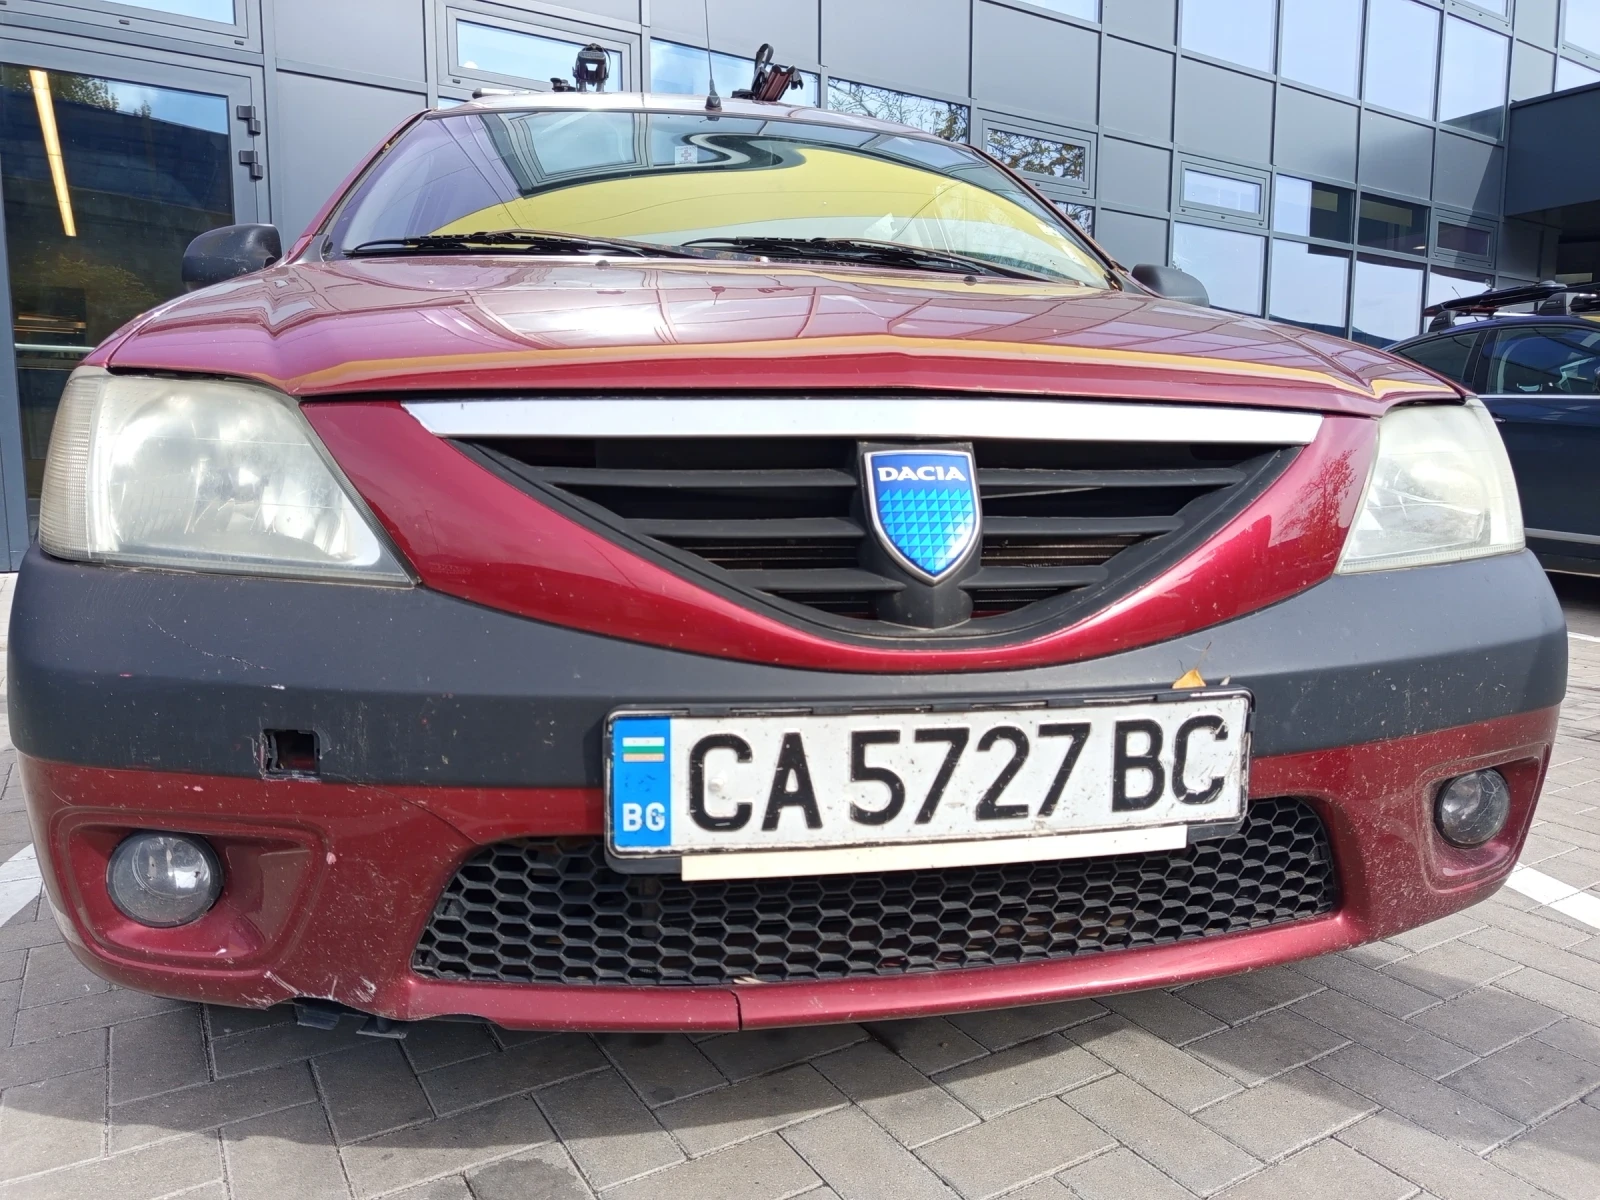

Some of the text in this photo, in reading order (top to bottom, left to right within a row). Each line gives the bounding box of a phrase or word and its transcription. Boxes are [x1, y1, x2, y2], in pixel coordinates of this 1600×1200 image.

[877, 466, 966, 481] DACIA
[688, 714, 1229, 832] CA 5727 BC
[622, 802, 665, 832] BG
